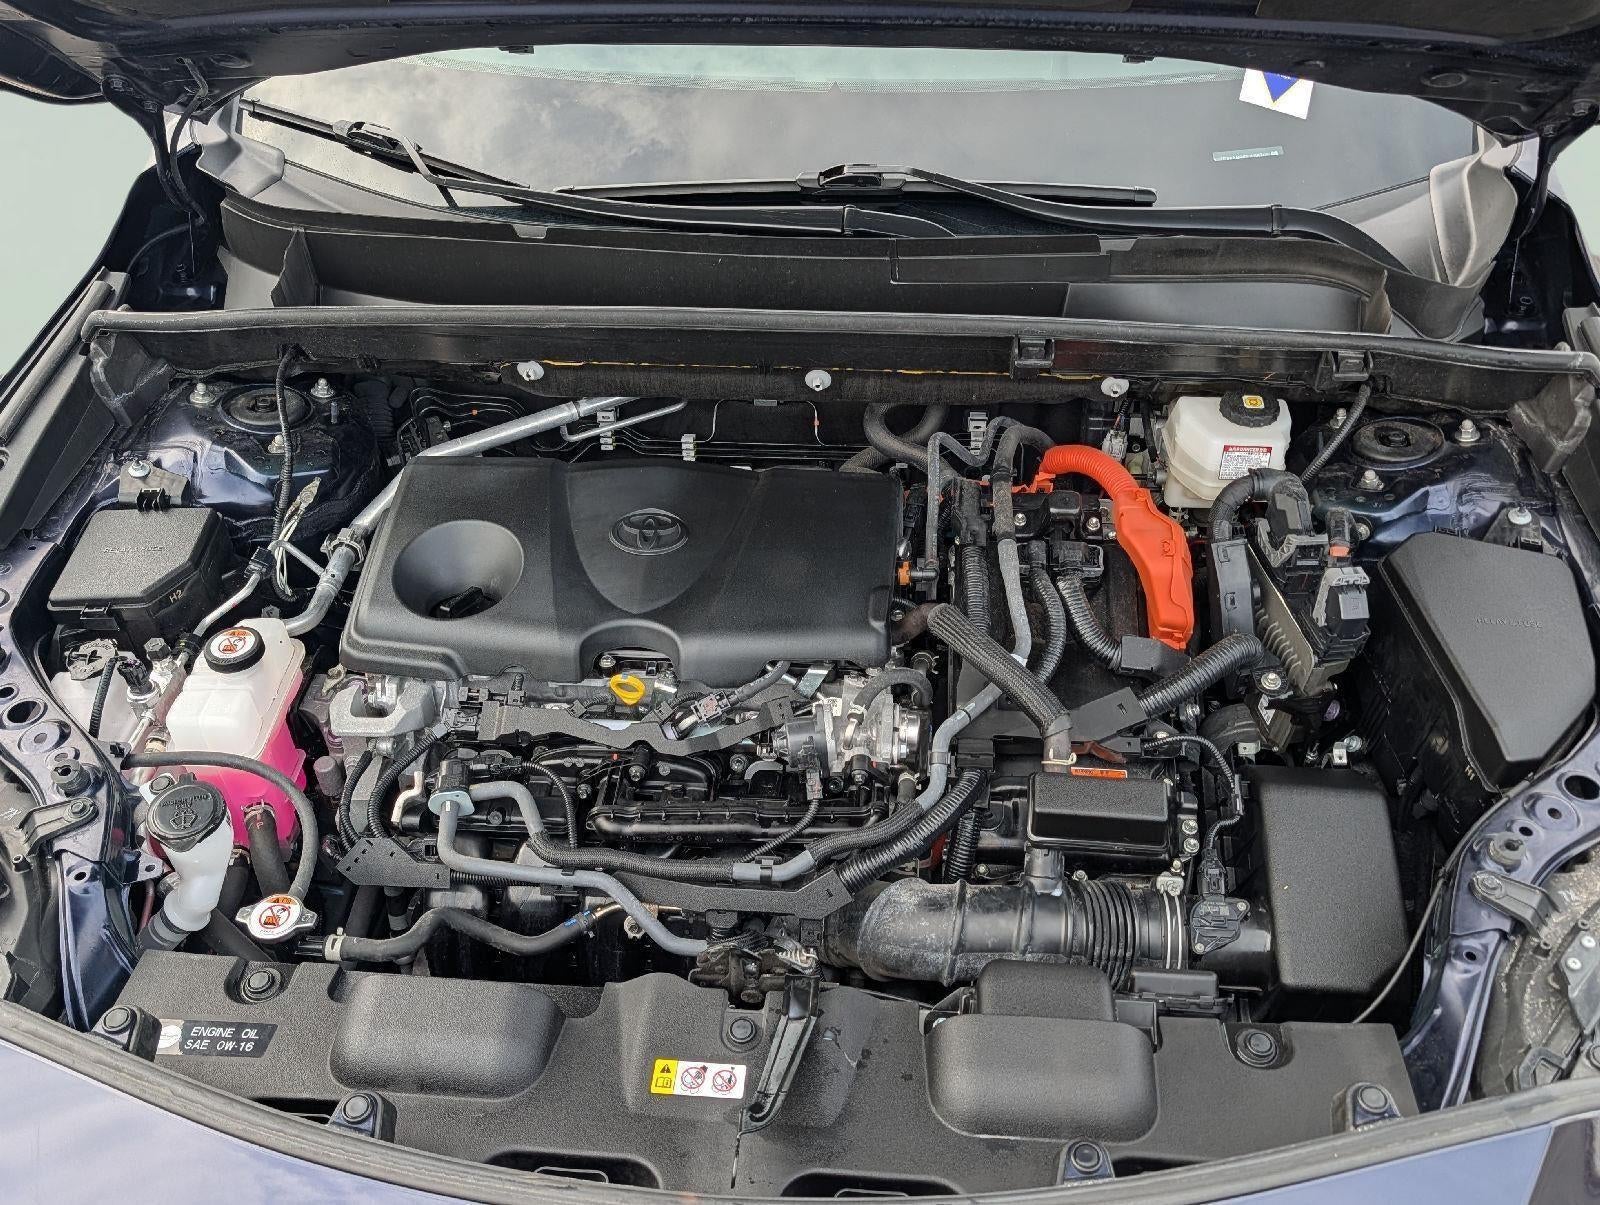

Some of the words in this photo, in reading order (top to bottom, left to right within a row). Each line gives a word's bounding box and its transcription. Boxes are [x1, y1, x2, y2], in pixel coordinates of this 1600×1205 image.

[169, 590, 182, 603] H2
[190, 1026, 236, 1038] ENGINE
[241, 1028, 260, 1039] OIL
[184, 1039, 211, 1050] SAE
[216, 1040, 255, 1052] 0W-16
